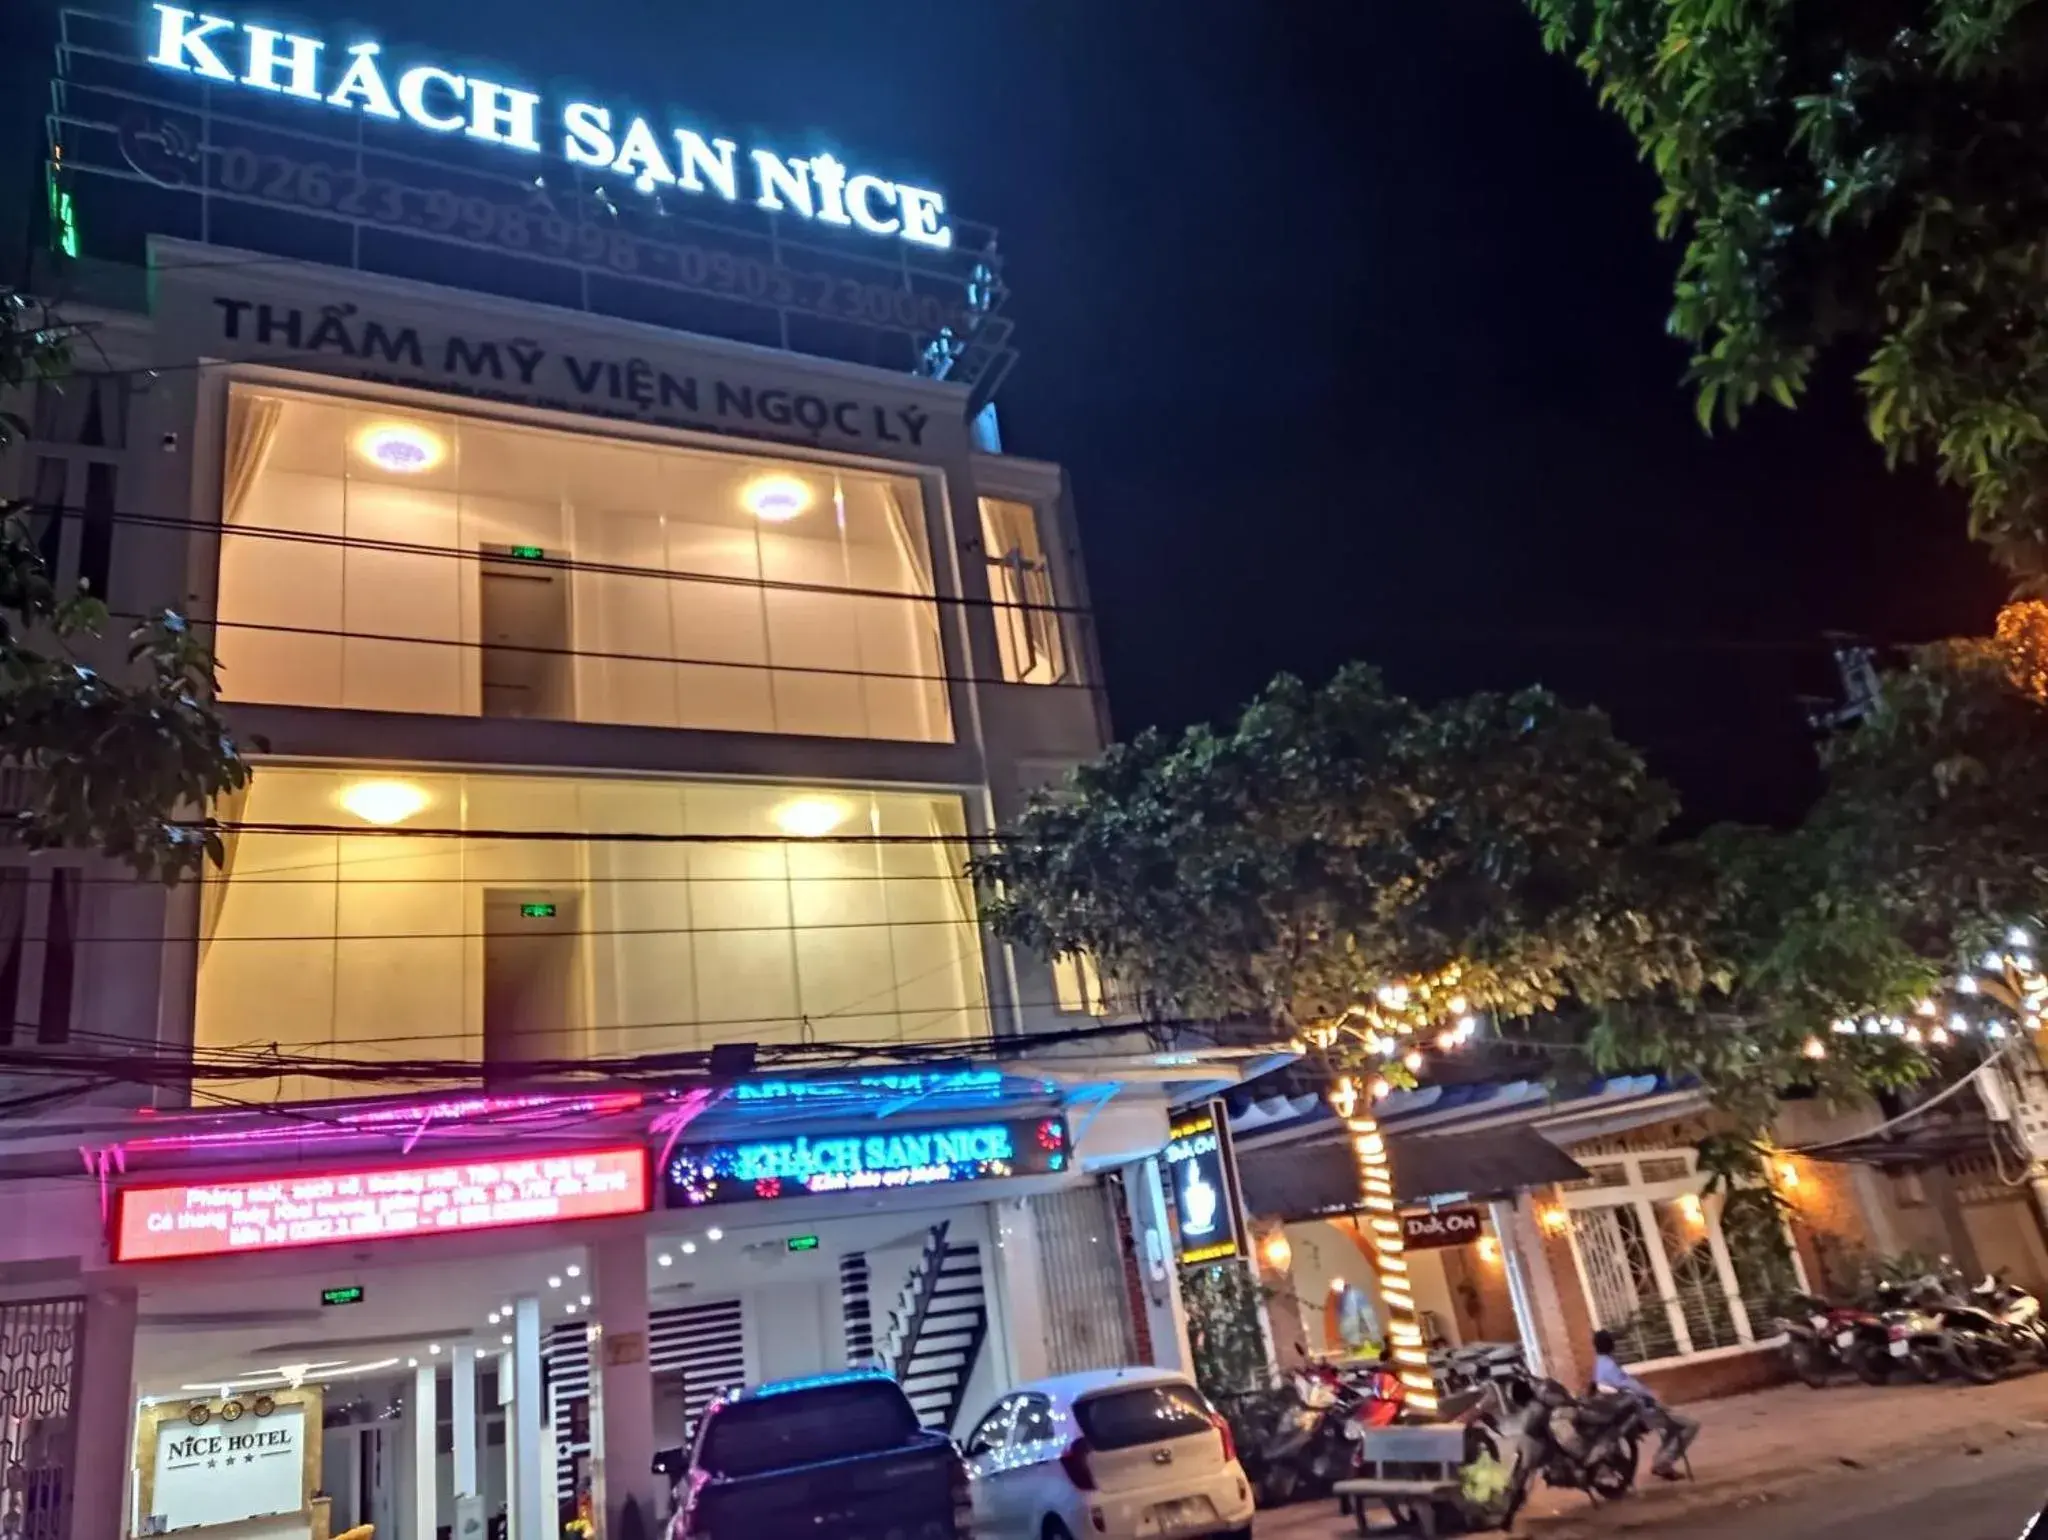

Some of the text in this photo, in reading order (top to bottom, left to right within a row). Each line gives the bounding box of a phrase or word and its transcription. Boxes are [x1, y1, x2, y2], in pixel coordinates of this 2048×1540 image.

[149, 3, 952, 249] KHÁCH SẠN NICE
[213, 297, 424, 367] THẨM
[444, 334, 545, 383] MỸ
[564, 356, 698, 412] VIỆN
[715, 381, 862, 437] NGỌC
[873, 402, 930, 447] LÝ
[734, 1136, 861, 1182] KHÁCH
[933, 1124, 1012, 1164] NICE
[168, 1429, 293, 1460] NICE HOTEL
